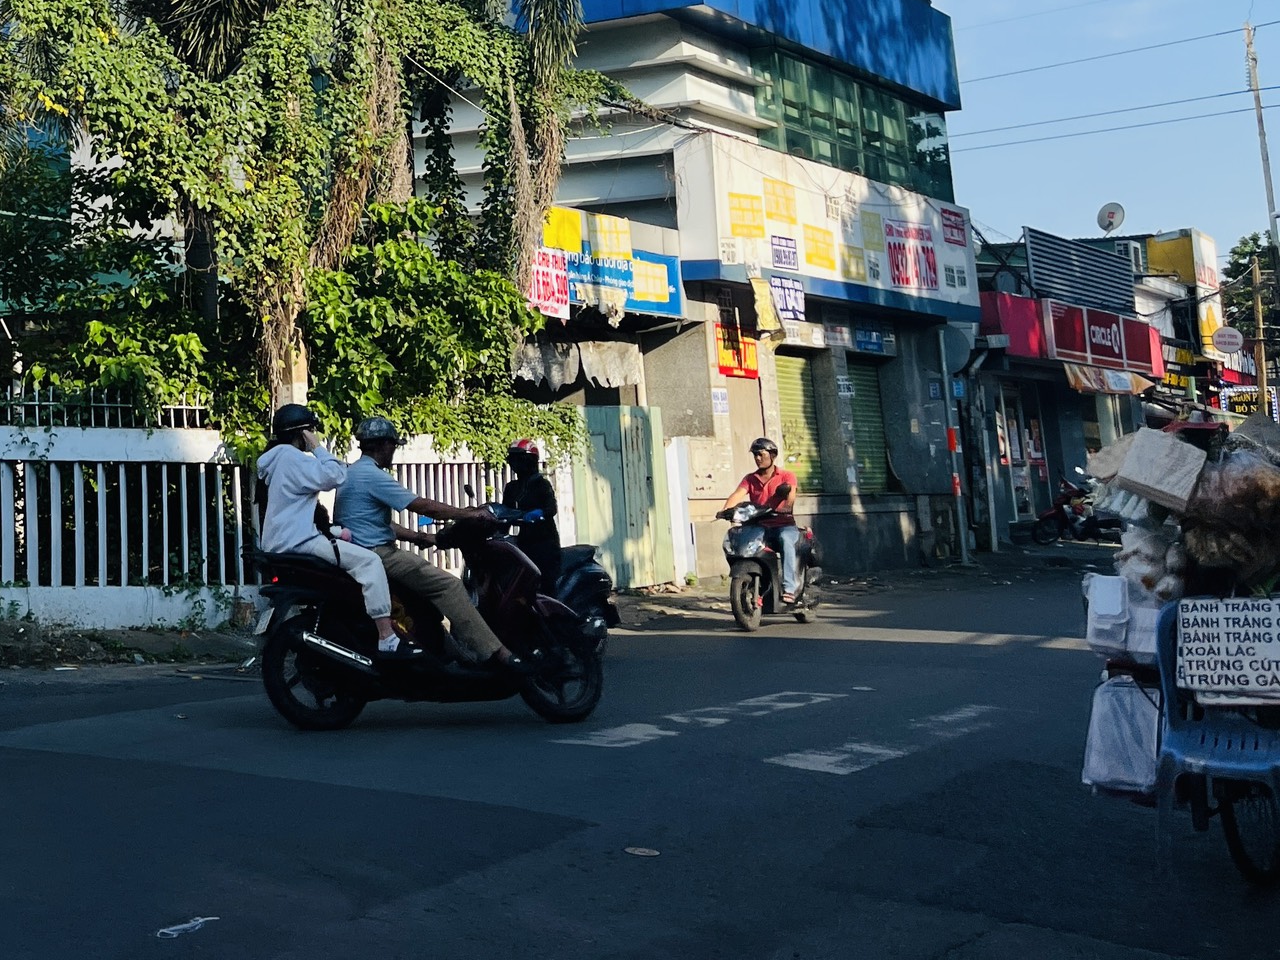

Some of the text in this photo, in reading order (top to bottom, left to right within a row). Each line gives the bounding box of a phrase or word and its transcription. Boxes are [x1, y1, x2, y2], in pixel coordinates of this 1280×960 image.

[1090, 325, 1112, 346] CIRCLE
[1180, 601, 1218, 613] BÁNH
[1223, 600, 1272, 613] TRÁNG
[1182, 614, 1272, 628] BÁNH TRÁNG
[1183, 630, 1220, 643] BÁNH
[1224, 629, 1273, 643] TRÁNG
[1186, 644, 1220, 656] XOÀI
[1185, 657, 1244, 671] TRỨNG
[1187, 671, 1250, 686] TRỨNG
